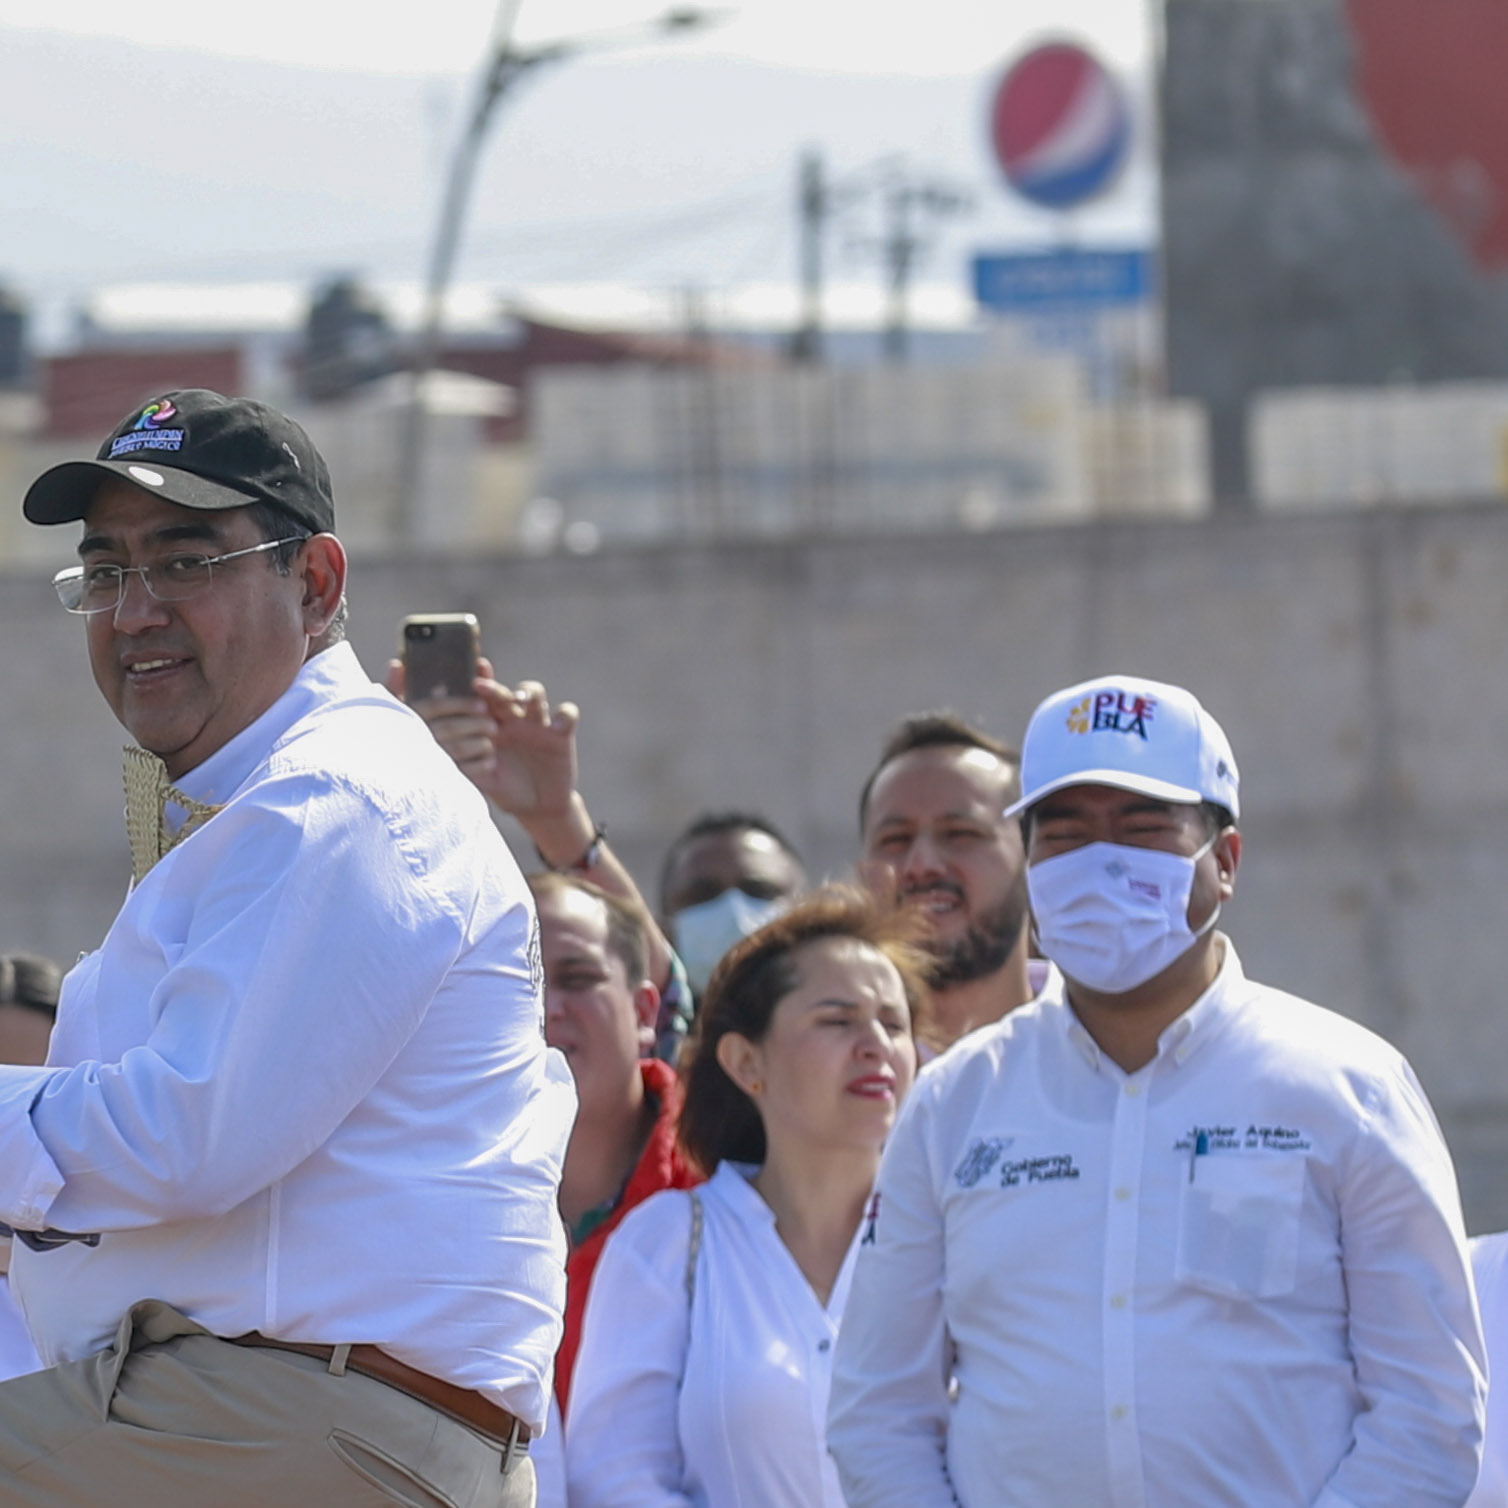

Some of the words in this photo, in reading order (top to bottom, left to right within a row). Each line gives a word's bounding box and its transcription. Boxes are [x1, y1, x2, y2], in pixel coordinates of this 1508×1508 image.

[1094, 692, 1158, 720] PUE
[1092, 711, 1148, 742] BLA
[1000, 1174, 1020, 1188] de
[1028, 1163, 1080, 1184] Puebla
[1001, 1153, 1073, 1175] Gobierno
